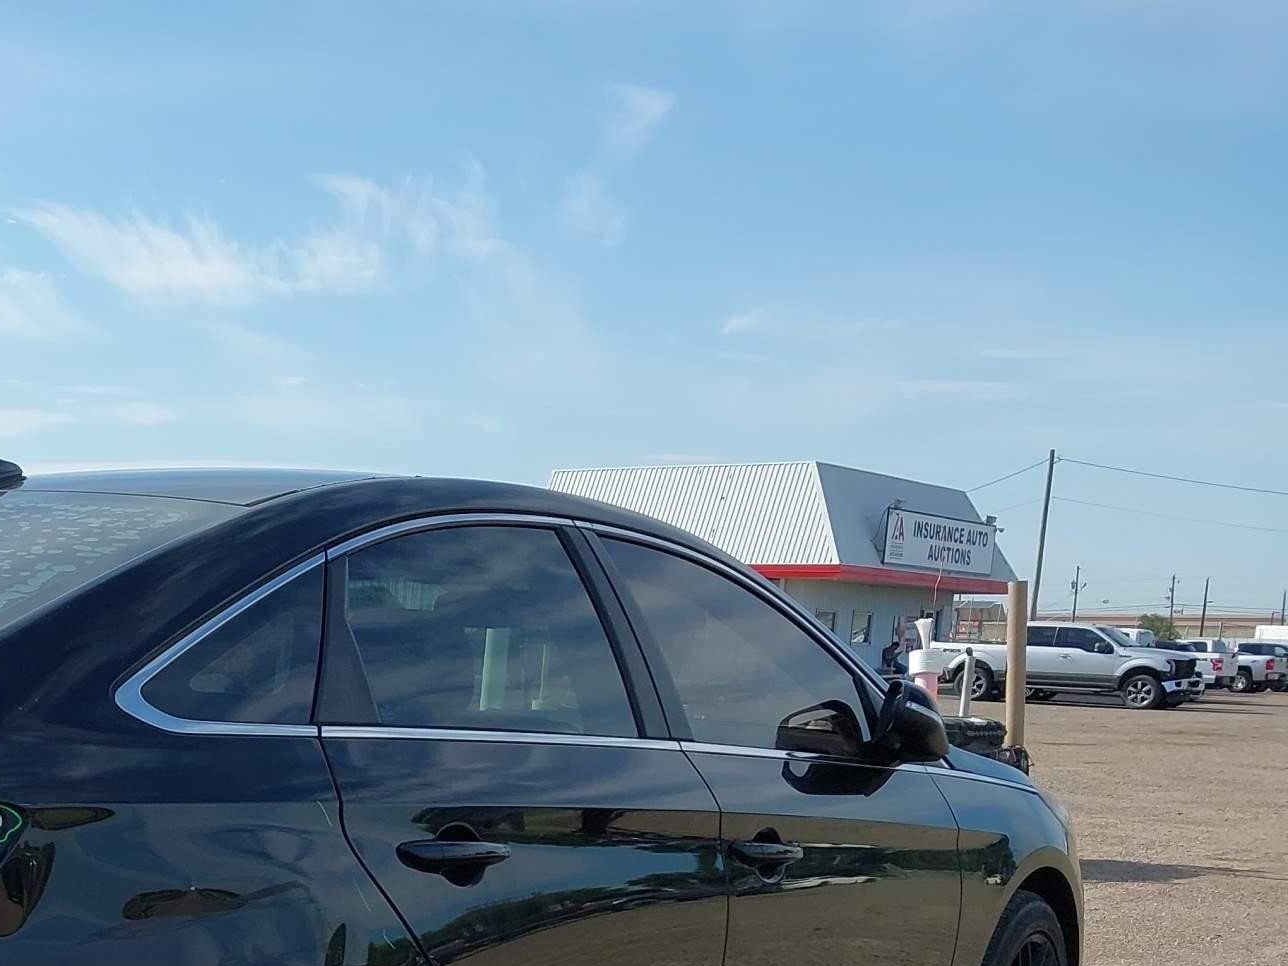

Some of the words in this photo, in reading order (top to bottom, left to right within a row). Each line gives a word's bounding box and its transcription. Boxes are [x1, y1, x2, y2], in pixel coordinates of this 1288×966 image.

[913, 519, 965, 545] INSURANCE
[966, 529, 989, 548] AUTO
[927, 544, 972, 566] AUCTIONS
